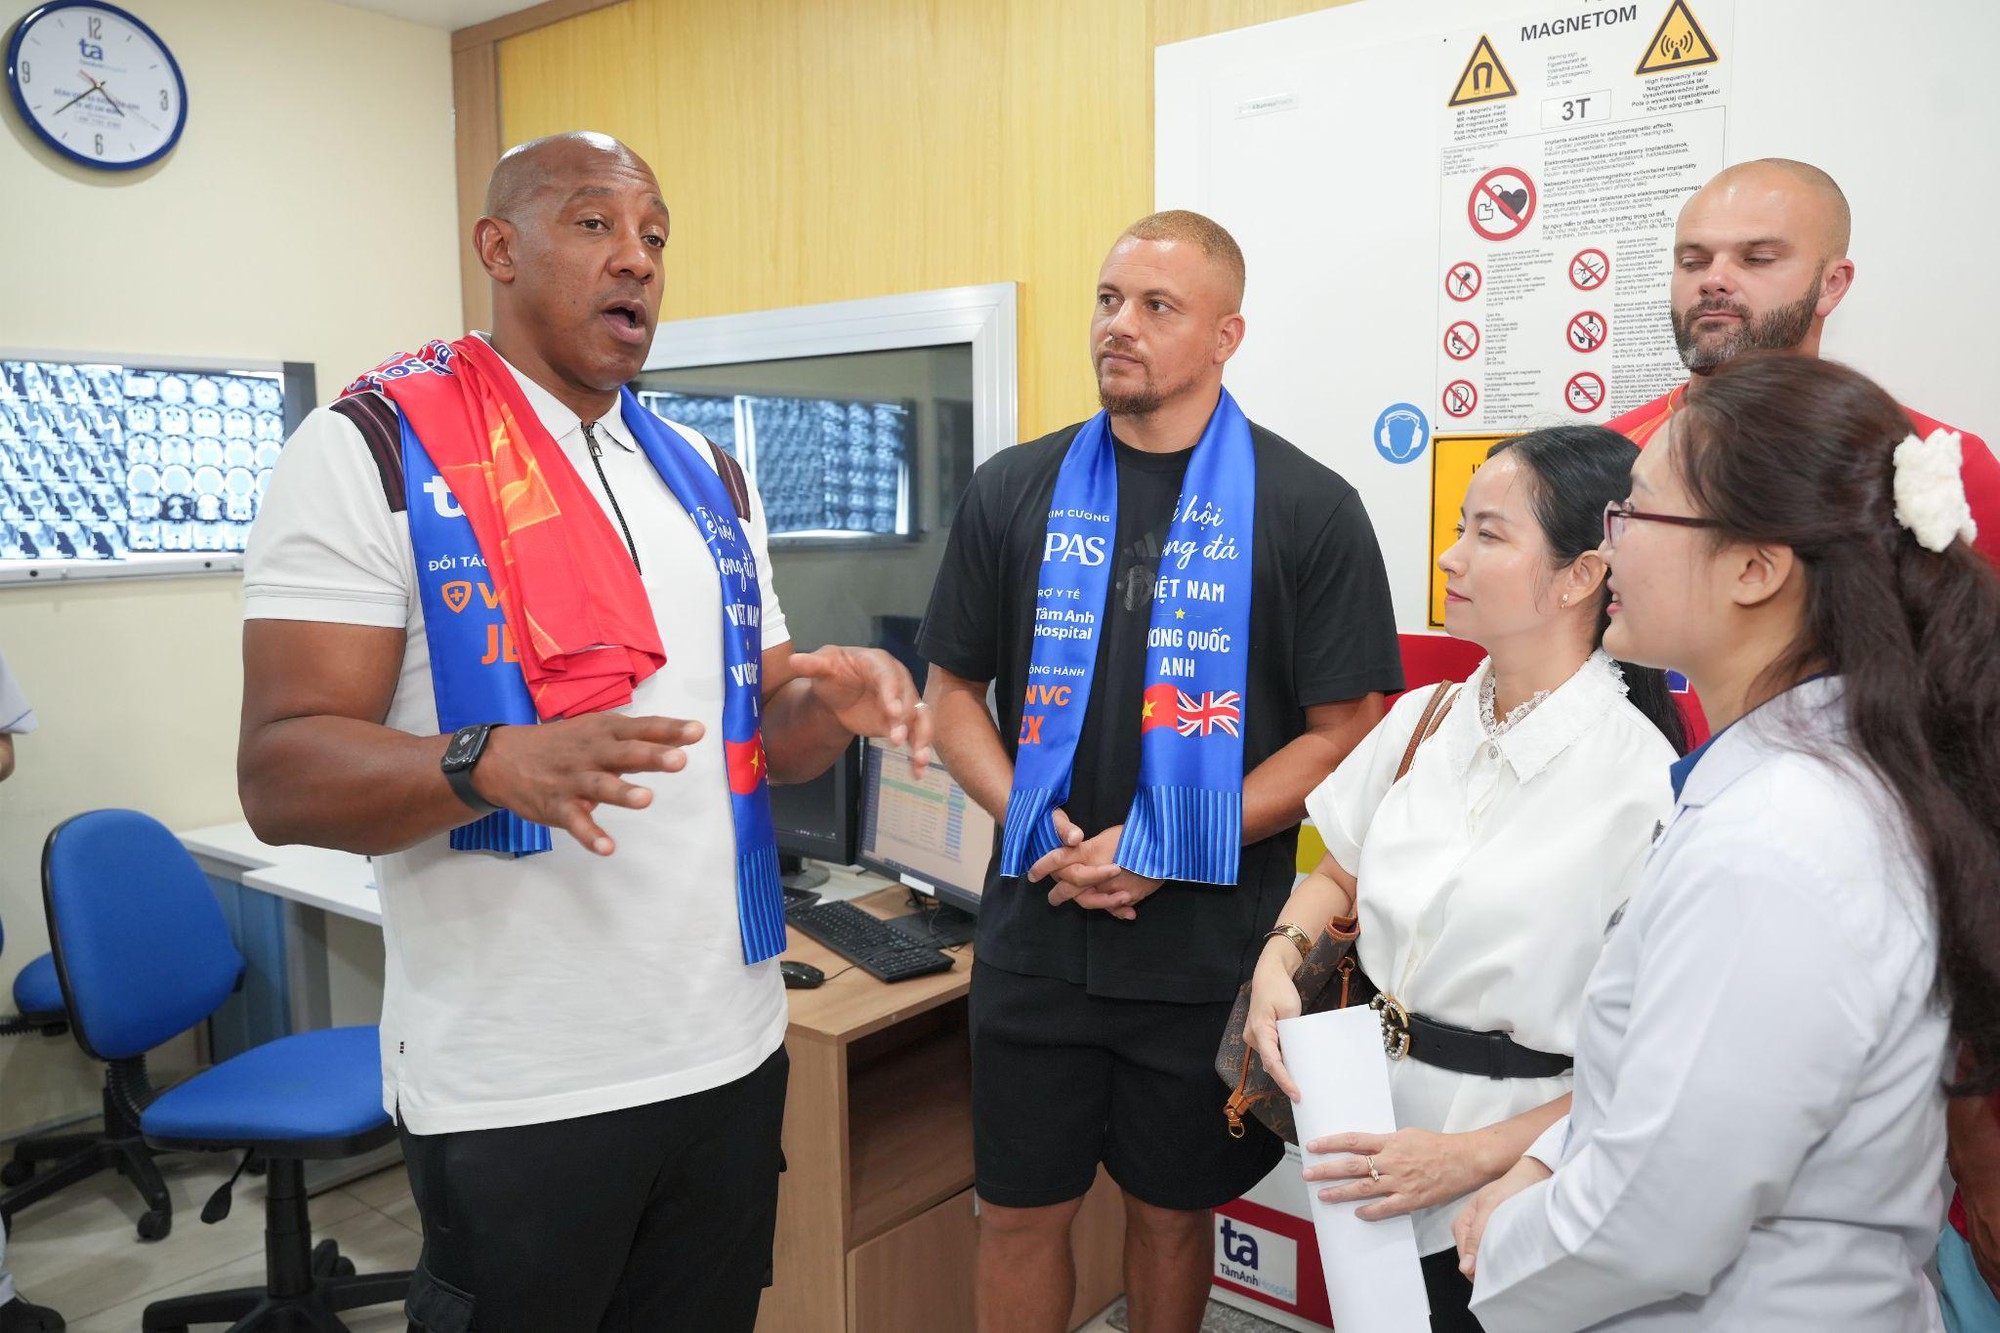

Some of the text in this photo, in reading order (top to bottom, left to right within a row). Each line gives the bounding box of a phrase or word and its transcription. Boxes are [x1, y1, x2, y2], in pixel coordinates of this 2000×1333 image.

[88, 16, 102, 40] 12
[1521, 5, 1636, 41] MAGNETOM
[78, 38, 103, 61] ta
[22, 61, 31, 83] 9
[160, 90, 169, 111] 3
[1562, 98, 1591, 121] 3T
[95, 134, 103, 155] 6
[1182, 495, 1224, 531] hội
[428, 554, 456, 572] ĐỐI
[1161, 534, 1240, 570] ng đá
[1037, 587, 1081, 600] RỢ Y TẾ
[1154, 575, 1226, 604] IỆT NAM
[1035, 607, 1095, 624] Tâm Anh
[1033, 623, 1092, 641] Hospital
[1187, 627, 1231, 653] QUỐC
[481, 624, 520, 665] JE
[1029, 662, 1085, 677] ỒNG HÀNH
[1160, 656, 1195, 678] ANH
[1025, 684, 1072, 706] NVC
[1221, 1219, 1258, 1270] ta
